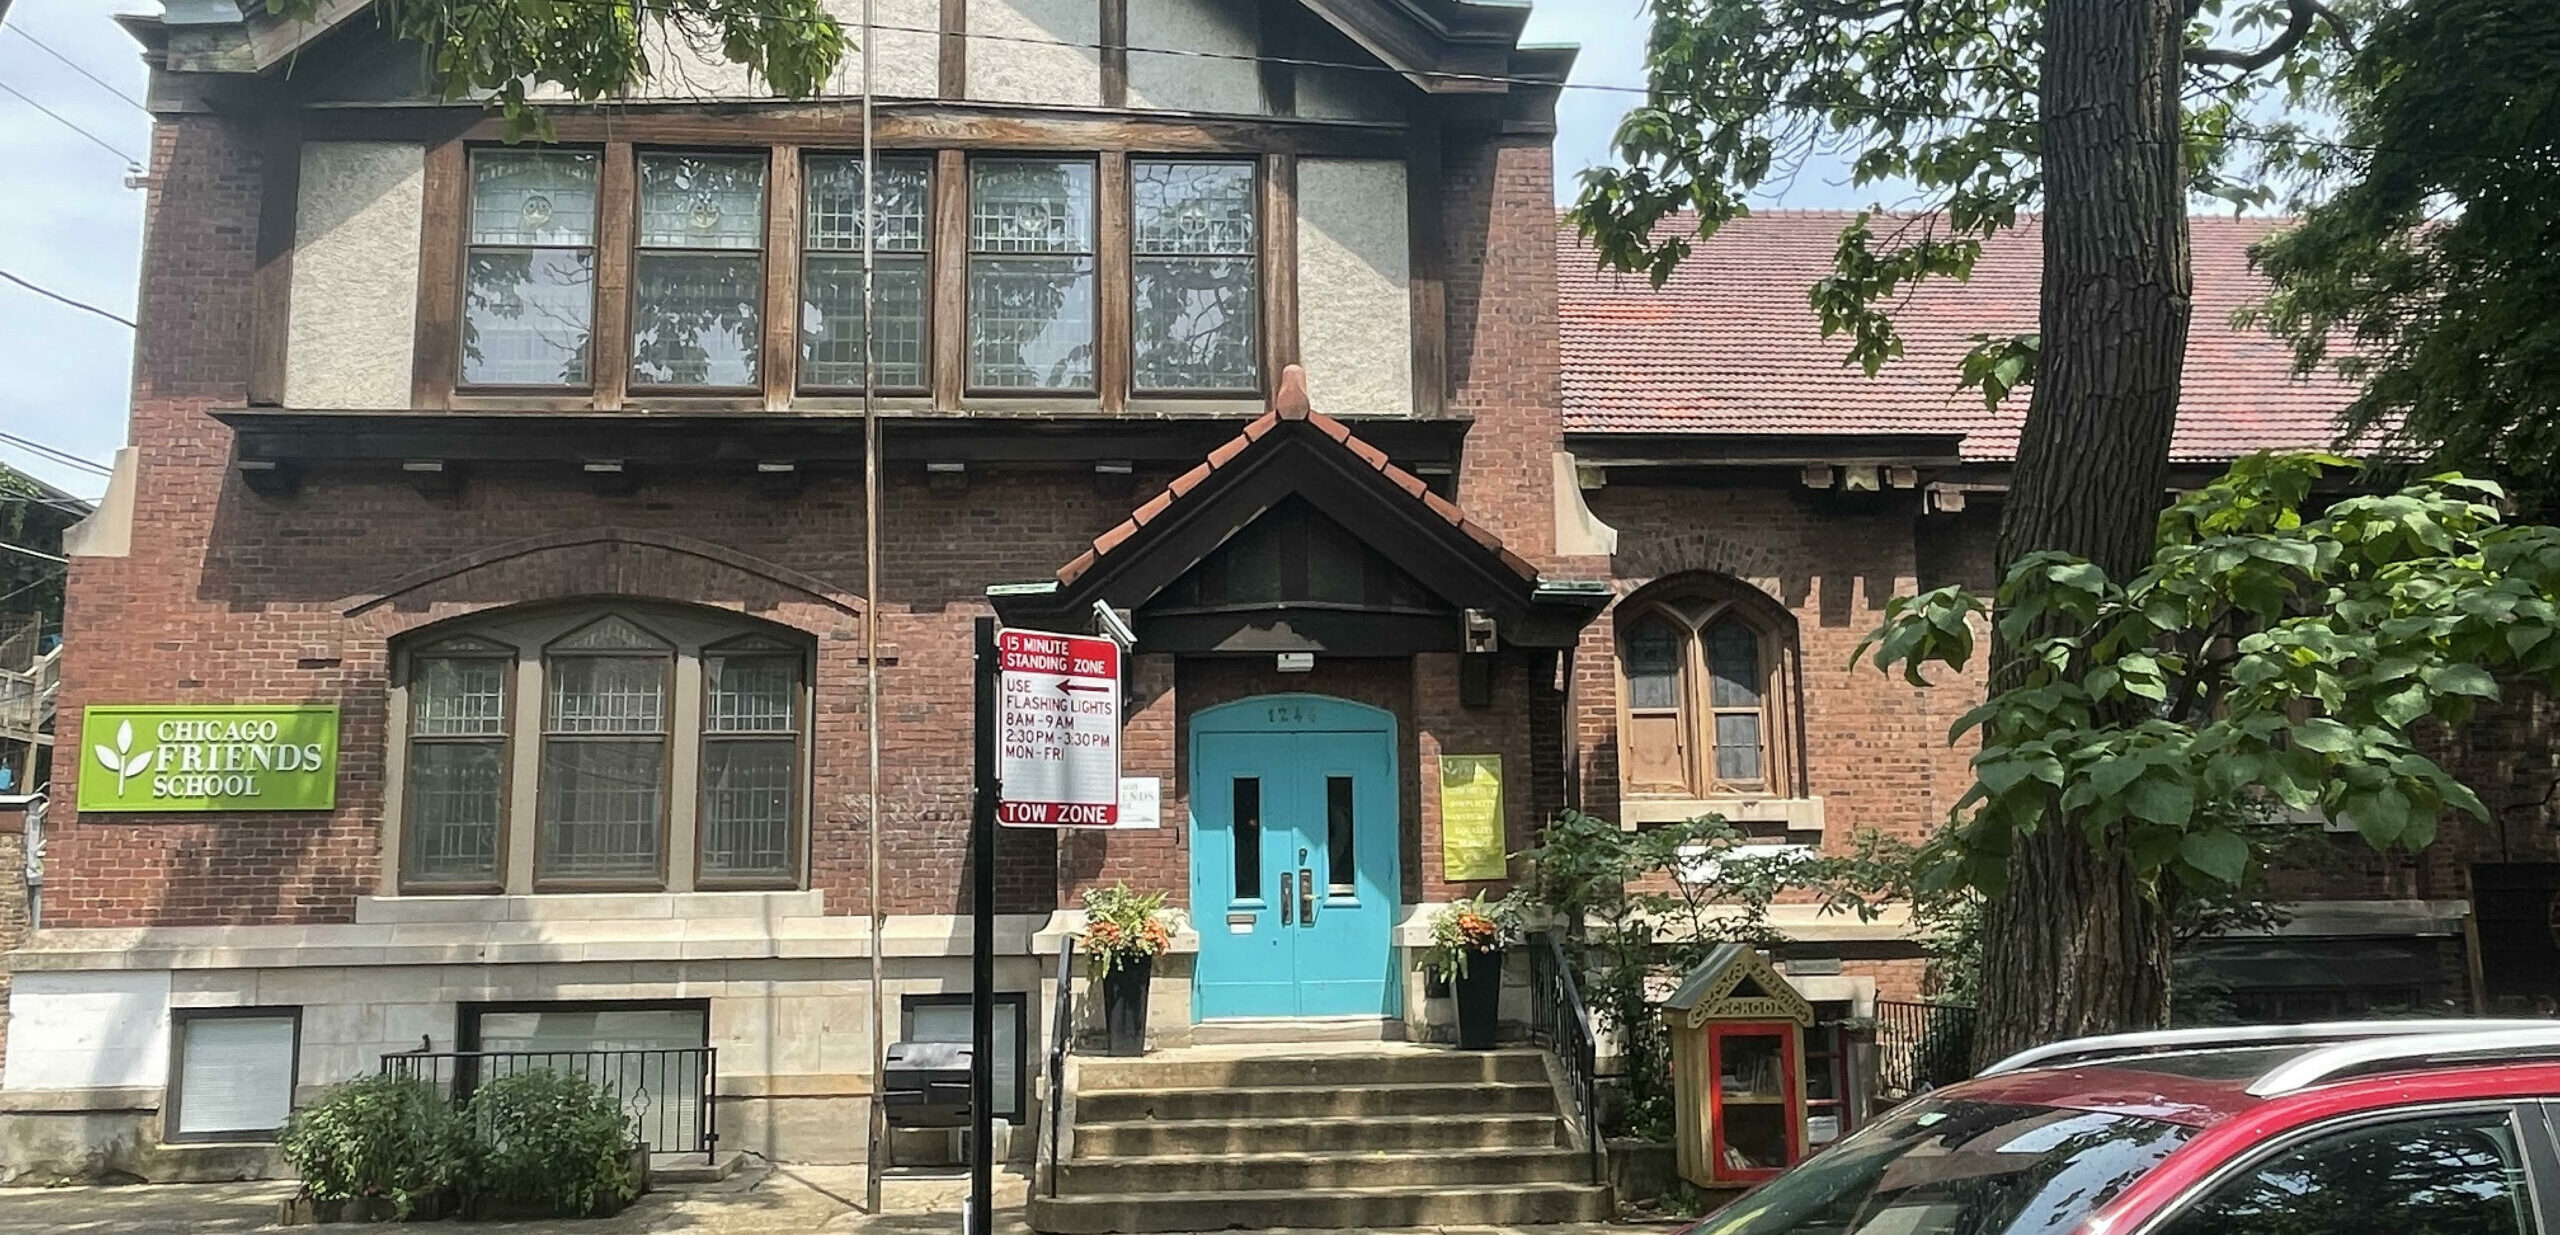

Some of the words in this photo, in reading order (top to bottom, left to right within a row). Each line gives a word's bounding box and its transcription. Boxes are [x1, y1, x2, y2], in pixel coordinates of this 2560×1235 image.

[1006, 636, 1020, 651] 15
[1023, 638, 1069, 656] MINUTE
[1007, 653, 1067, 671] STANDING
[1073, 658, 1106, 675] ZONE
[1006, 679, 1032, 693] USE
[1006, 695, 1068, 712] FLASHING
[1070, 699, 1113, 715] LIGHTS
[157, 719, 279, 742] CHICAGO
[154, 742, 323, 773] FRIENDS
[152, 774, 262, 798] SCHOOL
[1005, 803, 1047, 823] TOW
[1057, 804, 1108, 824] ZONE
